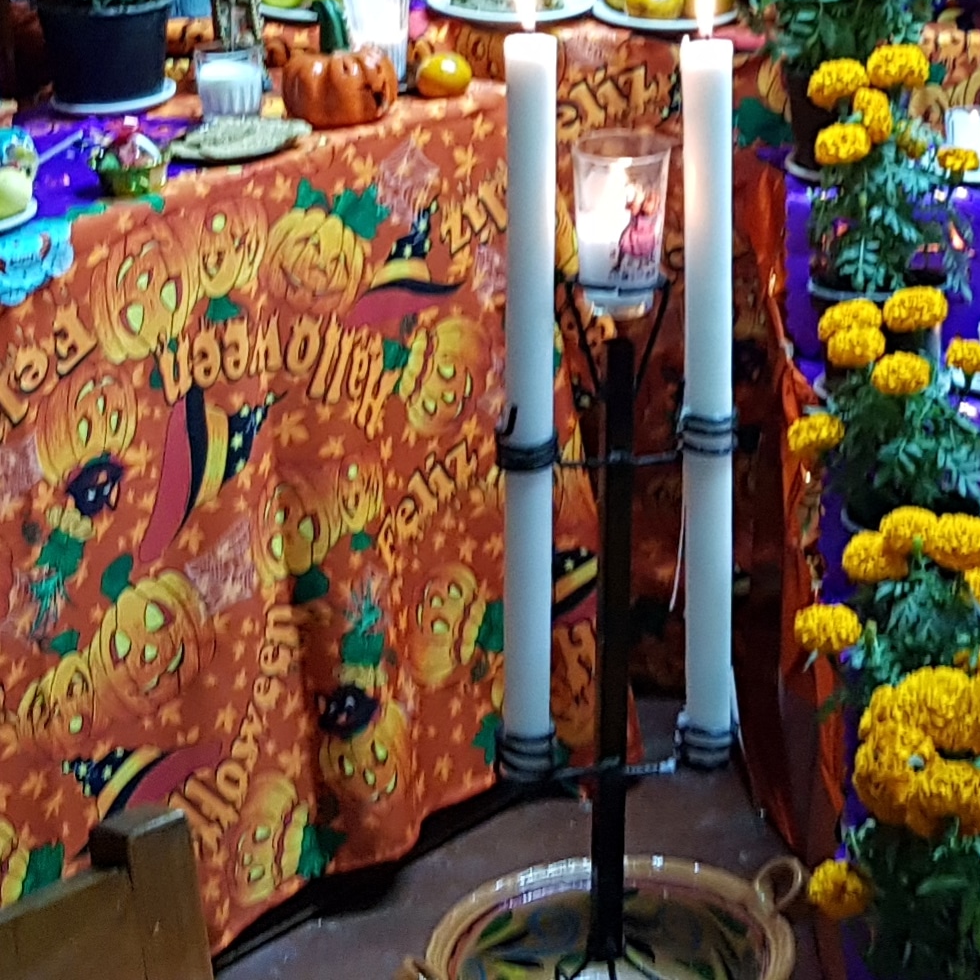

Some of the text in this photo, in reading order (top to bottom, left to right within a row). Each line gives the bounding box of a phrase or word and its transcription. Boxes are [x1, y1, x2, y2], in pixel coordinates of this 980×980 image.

[556, 60, 660, 142] eliz
[440, 158, 508, 258] liz
[0, 300, 97, 428] Fel
[157, 310, 399, 440] Halloween
[377, 438, 478, 576] Feliz
[168, 604, 300, 852] lloween
